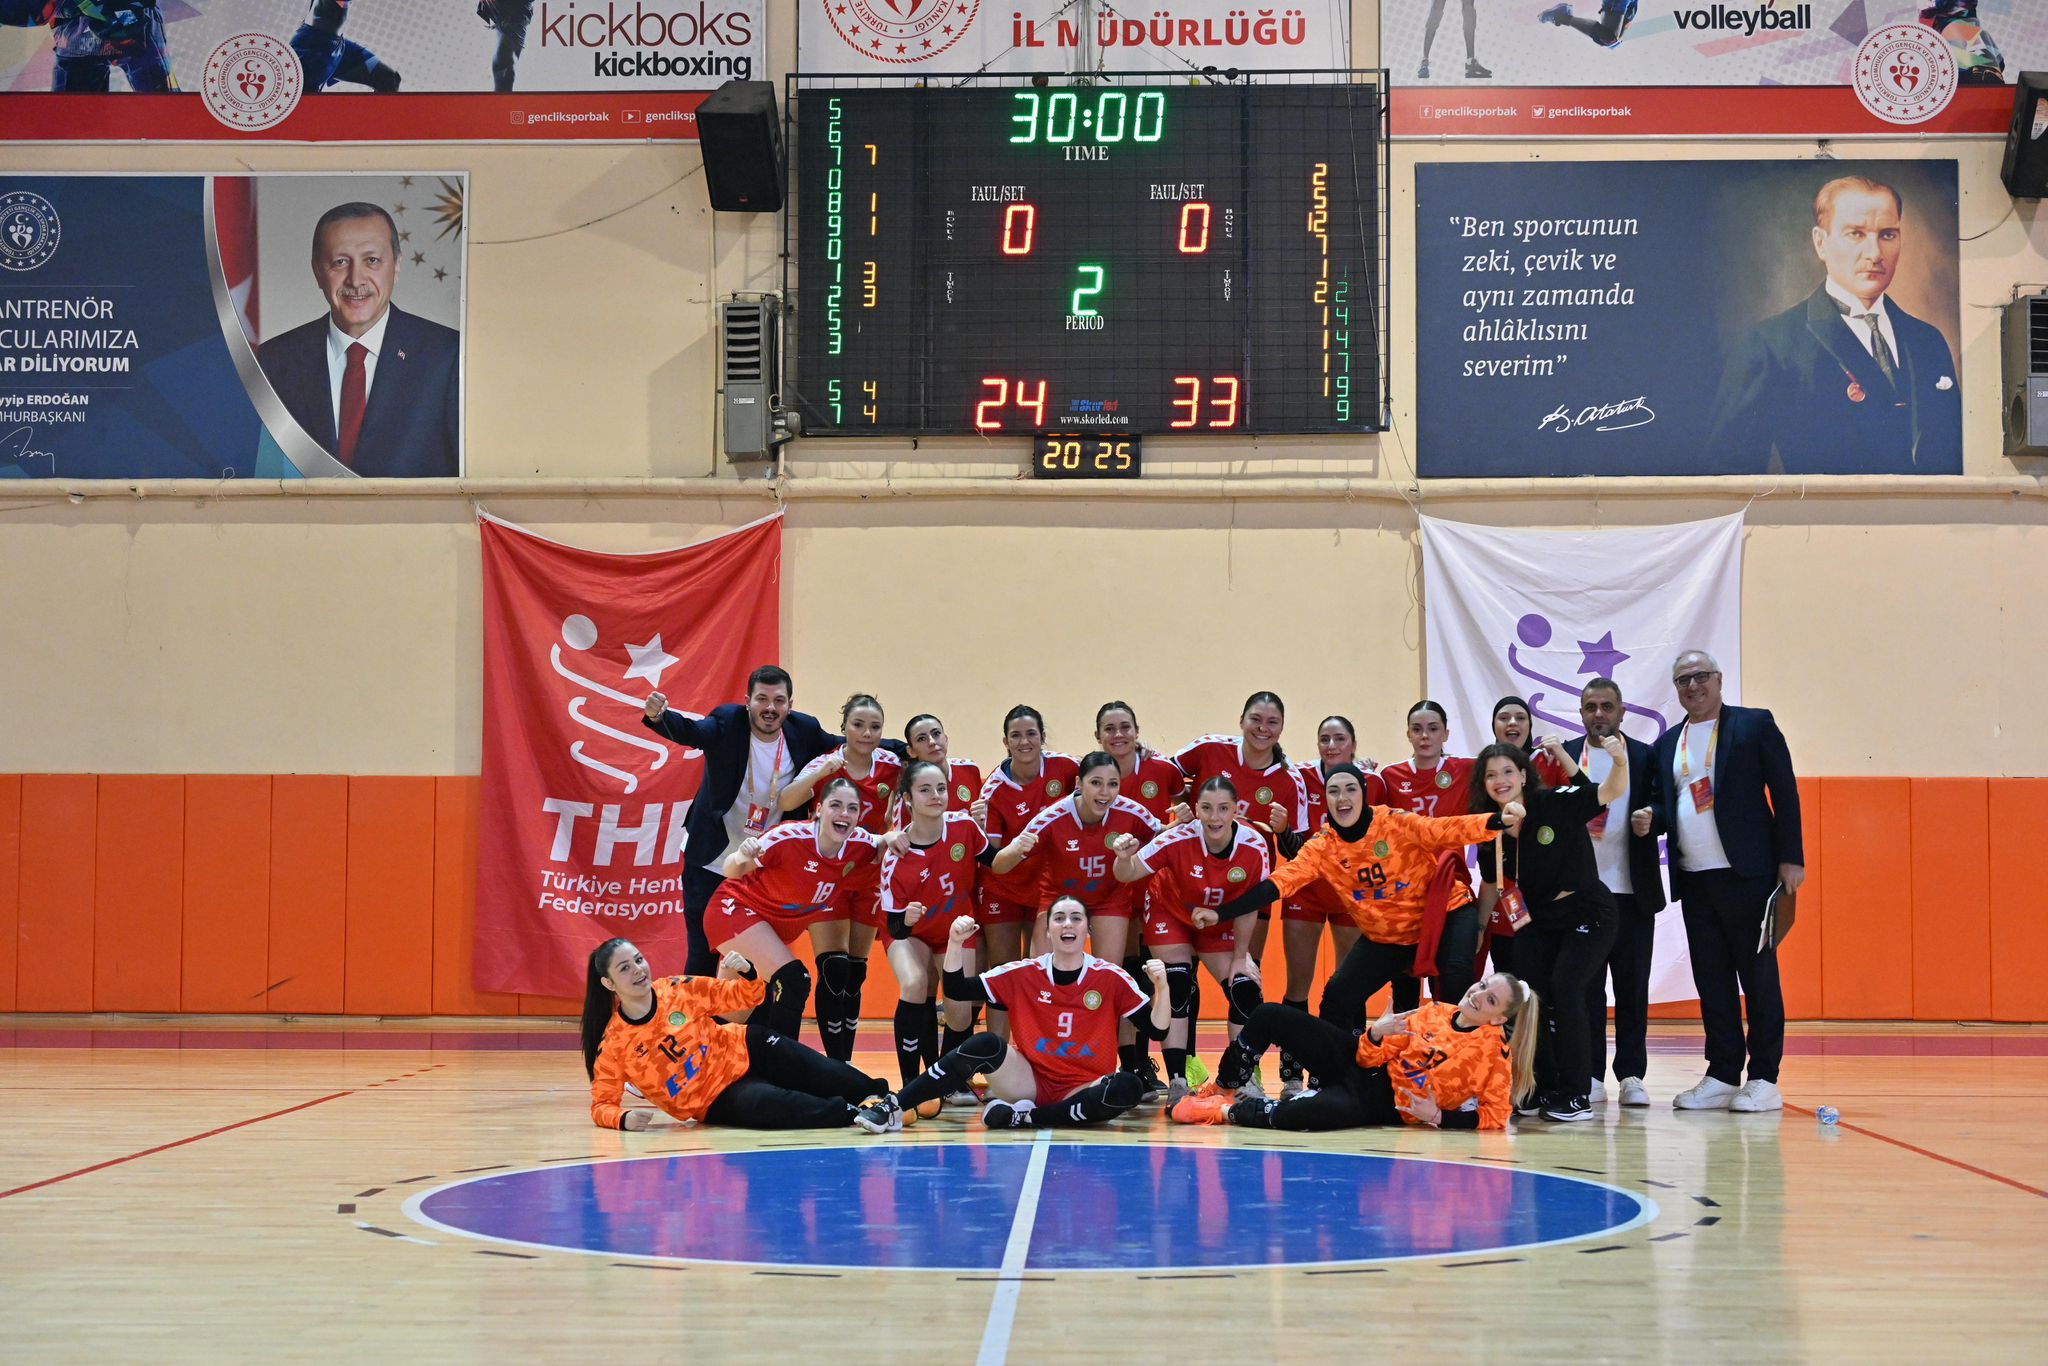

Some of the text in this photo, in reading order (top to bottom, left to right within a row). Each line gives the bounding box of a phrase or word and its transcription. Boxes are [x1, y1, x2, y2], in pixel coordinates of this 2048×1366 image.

[541, 1, 752, 47] kickboks
[1013, 12, 1044, 47] İL
[1673, 4, 1811, 36] volleyball
[268, 57, 275, 65] VE
[273, 65, 281, 80] SPOR
[594, 50, 752, 81] kickboxing
[1921, 49, 1929, 57] VE
[1926, 56, 1935, 72] SPOR
[527, 110, 696, 124] gencliksporbak gencliksp
[829, 98, 841, 119] 5
[1010, 92, 1165, 143] 30:00
[1434, 106, 1517, 119] gencliksporbak
[1548, 106, 1631, 119] gencliksporbak
[829, 122, 841, 143] 6
[830, 144, 877, 166] 7 7
[1062, 145, 1109, 161] TIME
[828, 169, 841, 190] 0
[1312, 163, 1327, 186] 2
[971, 185, 1026, 203] FAUL/SET
[1150, 182, 1205, 200] FAUL/SET
[1313, 187, 1327, 209] 5
[828, 192, 841, 213] 8
[828, 215, 841, 237] 9
[1002, 204, 1035, 255] 0
[1178, 203, 1211, 253] 0
[1513, 217, 1638, 243] sporcunun
[828, 239, 841, 260] 0
[1315, 234, 1328, 255] 7
[863, 262, 876, 283] 3
[1462, 248, 1616, 277] zeki, çevik ve
[828, 285, 876, 307] 2 3
[1072, 265, 1104, 316] 2
[1314, 281, 1348, 303] 2 2
[1462, 282, 1635, 313] aynı zamanda
[0, 297, 113, 319] NTRENÖR
[1336, 307, 1348, 325] 4
[828, 309, 841, 331] 5
[1065, 315, 1104, 330] PERIOD
[1463, 318, 1588, 342] ahlâklısını
[828, 332, 841, 355] 3
[1336, 330, 1348, 349] 4
[0, 353, 129, 372] R DİLİYORUM
[1337, 352, 1349, 372] 7
[828, 379, 876, 401] 5 4
[1336, 376, 1349, 398] 9
[27, 393, 89, 405] ERDOĞAN
[975, 376, 1239, 429] 24 33
[0, 411, 85, 425] HURBAŞKANI
[829, 403, 876, 424] 7 4
[1060, 413, 1129, 425] www.skorled.com
[1336, 400, 1349, 421] 9
[1043, 441, 1132, 470] 20 25
[1411, 795, 1439, 818] 27
[1079, 855, 1106, 878] 45
[1357, 862, 1387, 888] 99
[540, 870, 622, 898] Türkiye
[811, 881, 836, 904] 18
[939, 872, 955, 896] 5
[1203, 886, 1225, 906] 13
[1057, 1012, 1074, 1038] 9
[657, 1034, 687, 1064] 12
